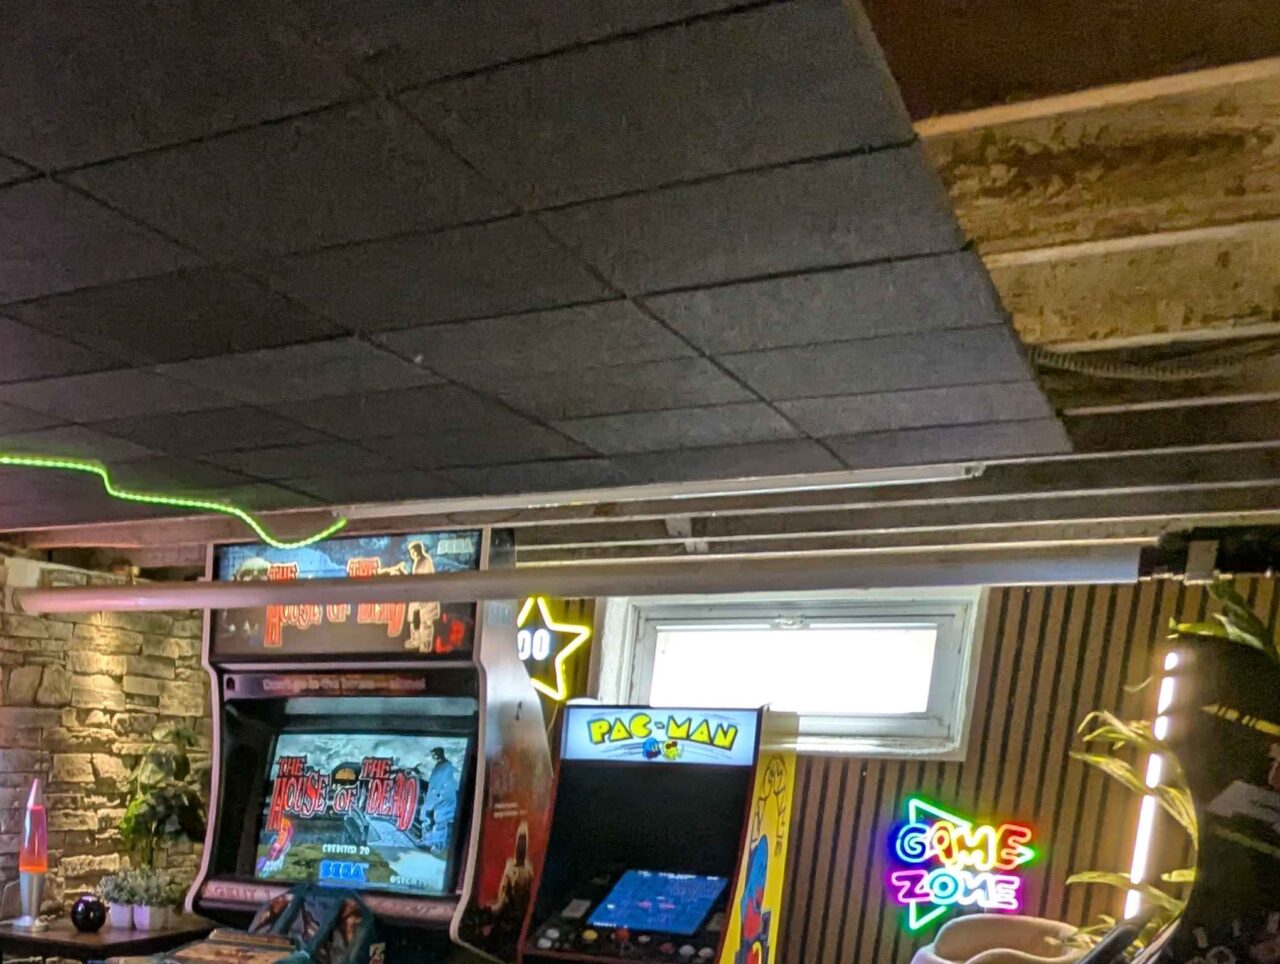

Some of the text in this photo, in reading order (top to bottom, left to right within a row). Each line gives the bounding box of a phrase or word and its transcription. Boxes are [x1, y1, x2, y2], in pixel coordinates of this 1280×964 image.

[587, 712, 738, 751] PAC-MAN
[278, 756, 307, 778] THE
[359, 756, 394, 779] THE
[266, 772, 360, 832] HOUSE OF
[365, 772, 419, 831] DEAD
[896, 821, 1034, 870] GAME
[320, 860, 368, 881] SEGA
[892, 868, 1020, 910] ZONE
